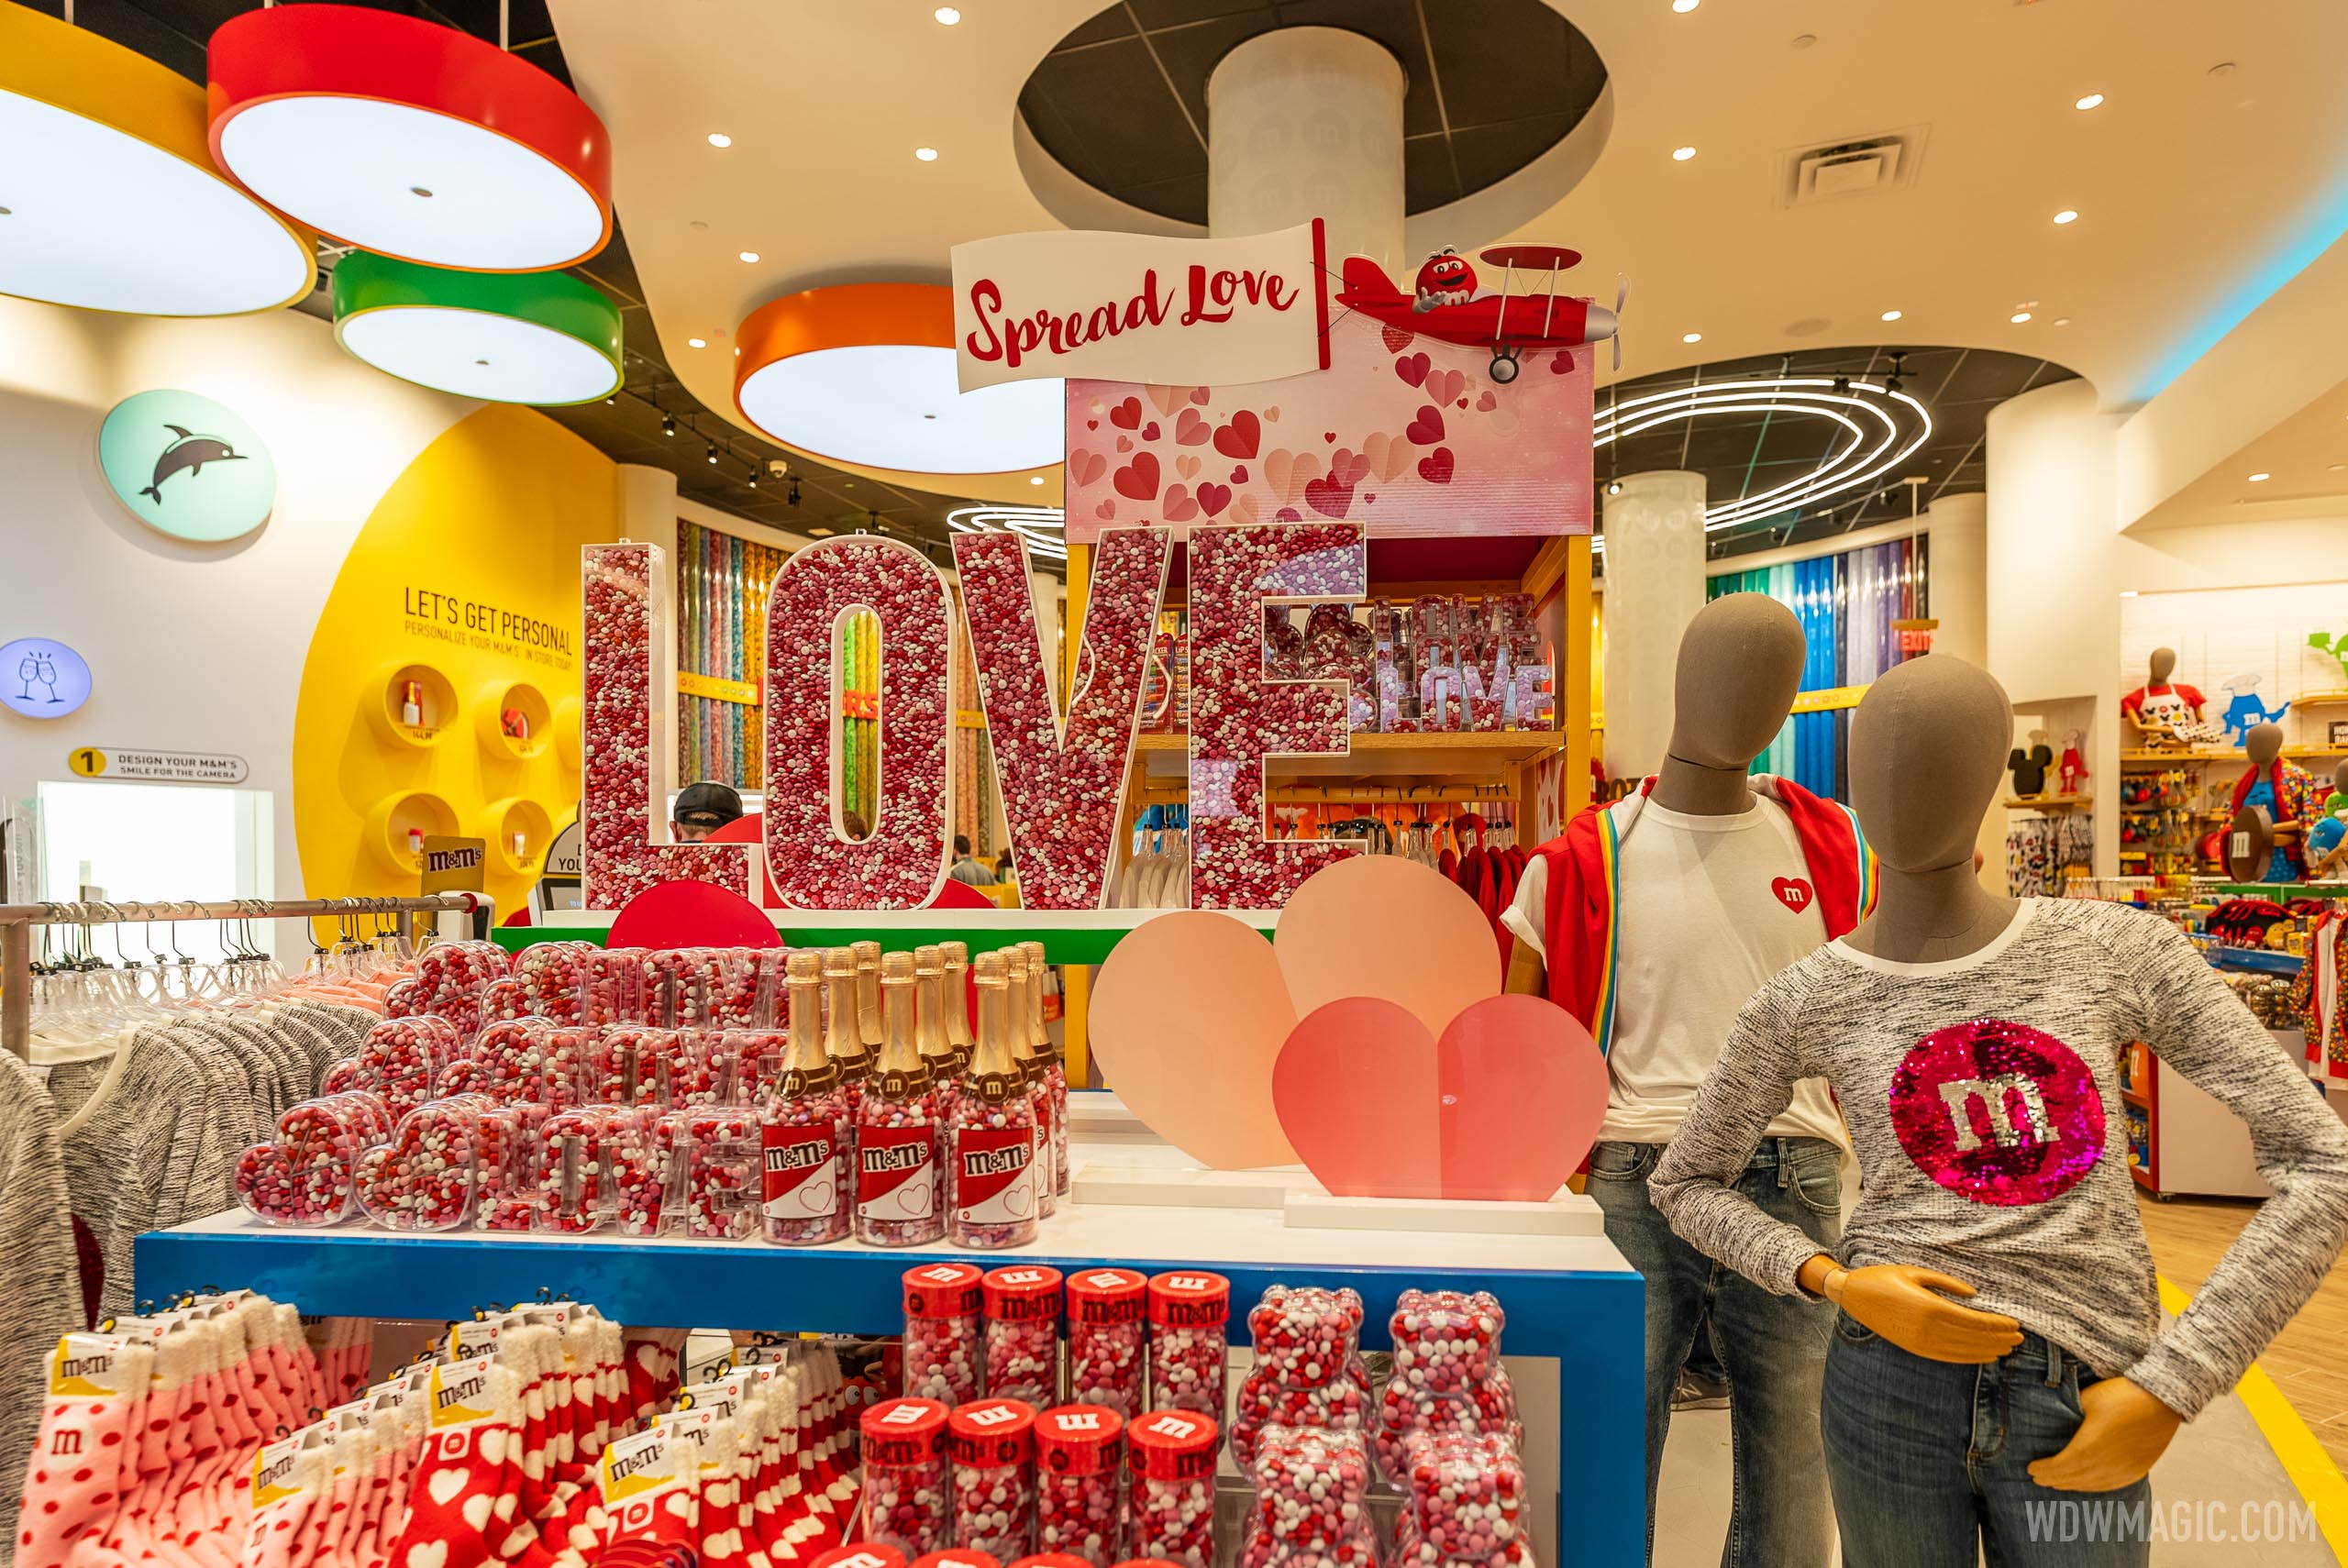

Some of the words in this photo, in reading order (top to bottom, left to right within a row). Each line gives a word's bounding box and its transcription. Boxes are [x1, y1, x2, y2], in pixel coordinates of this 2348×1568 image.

[966, 269, 1176, 369] Spread
[1180, 265, 1301, 327] Love
[405, 587, 458, 624] LET'S
[465, 602, 497, 634] GET
[502, 612, 572, 657] PERSONAL
[404, 620, 466, 646] PERSONALIZE
[470, 635, 491, 650] YOUR
[1900, 630, 1930, 651] EXIT
[1379, 665, 1553, 734] LOVE
[581, 523, 1368, 911] LOVE
[81, 750, 94, 772] 1
[118, 754, 162, 766] DESIGN
[167, 756, 196, 767] YOUR
[199, 759, 238, 769] M&M'S
[120, 767, 150, 776] SMILE
[153, 767, 173, 776] FOR
[175, 769, 194, 778] THE
[196, 770, 236, 778] CAMERA
[1783, 885, 1805, 903] m
[784, 1077, 800, 1091] m
[885, 1077, 903, 1093] m
[985, 1079, 1003, 1096] m
[1937, 1072, 2061, 1153] m
[50, 1429, 83, 1455] m
